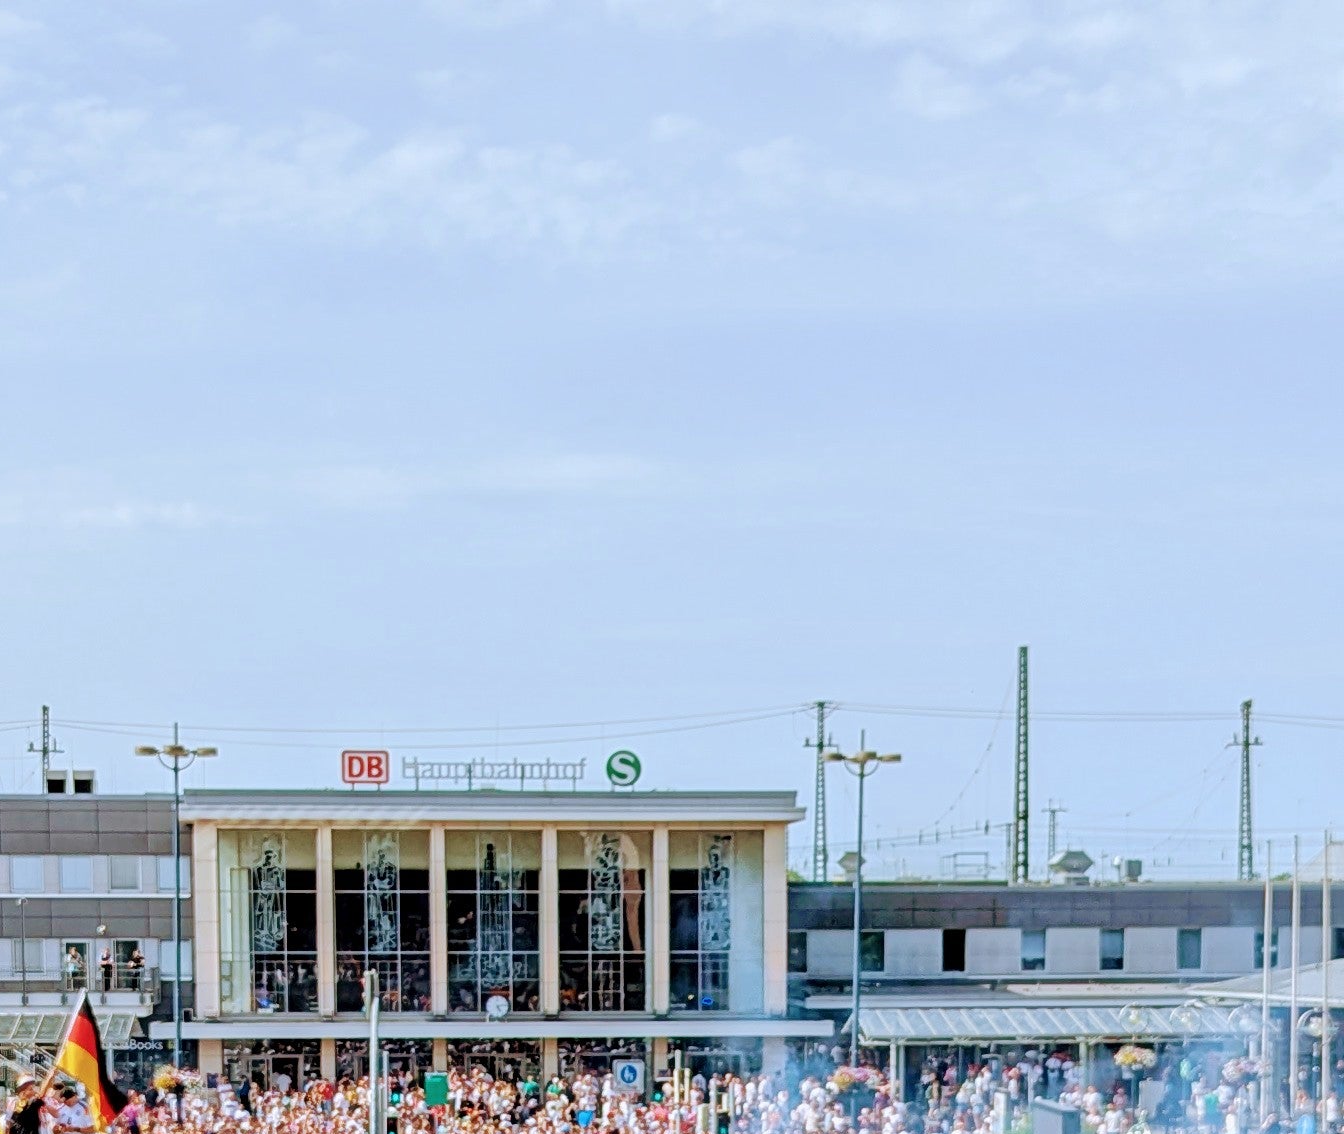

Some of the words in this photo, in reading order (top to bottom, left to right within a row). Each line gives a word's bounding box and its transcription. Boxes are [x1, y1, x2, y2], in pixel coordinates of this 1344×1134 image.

[348, 756, 384, 777] DB
[611, 753, 636, 785] S
[130, 1039, 163, 1050] Books
